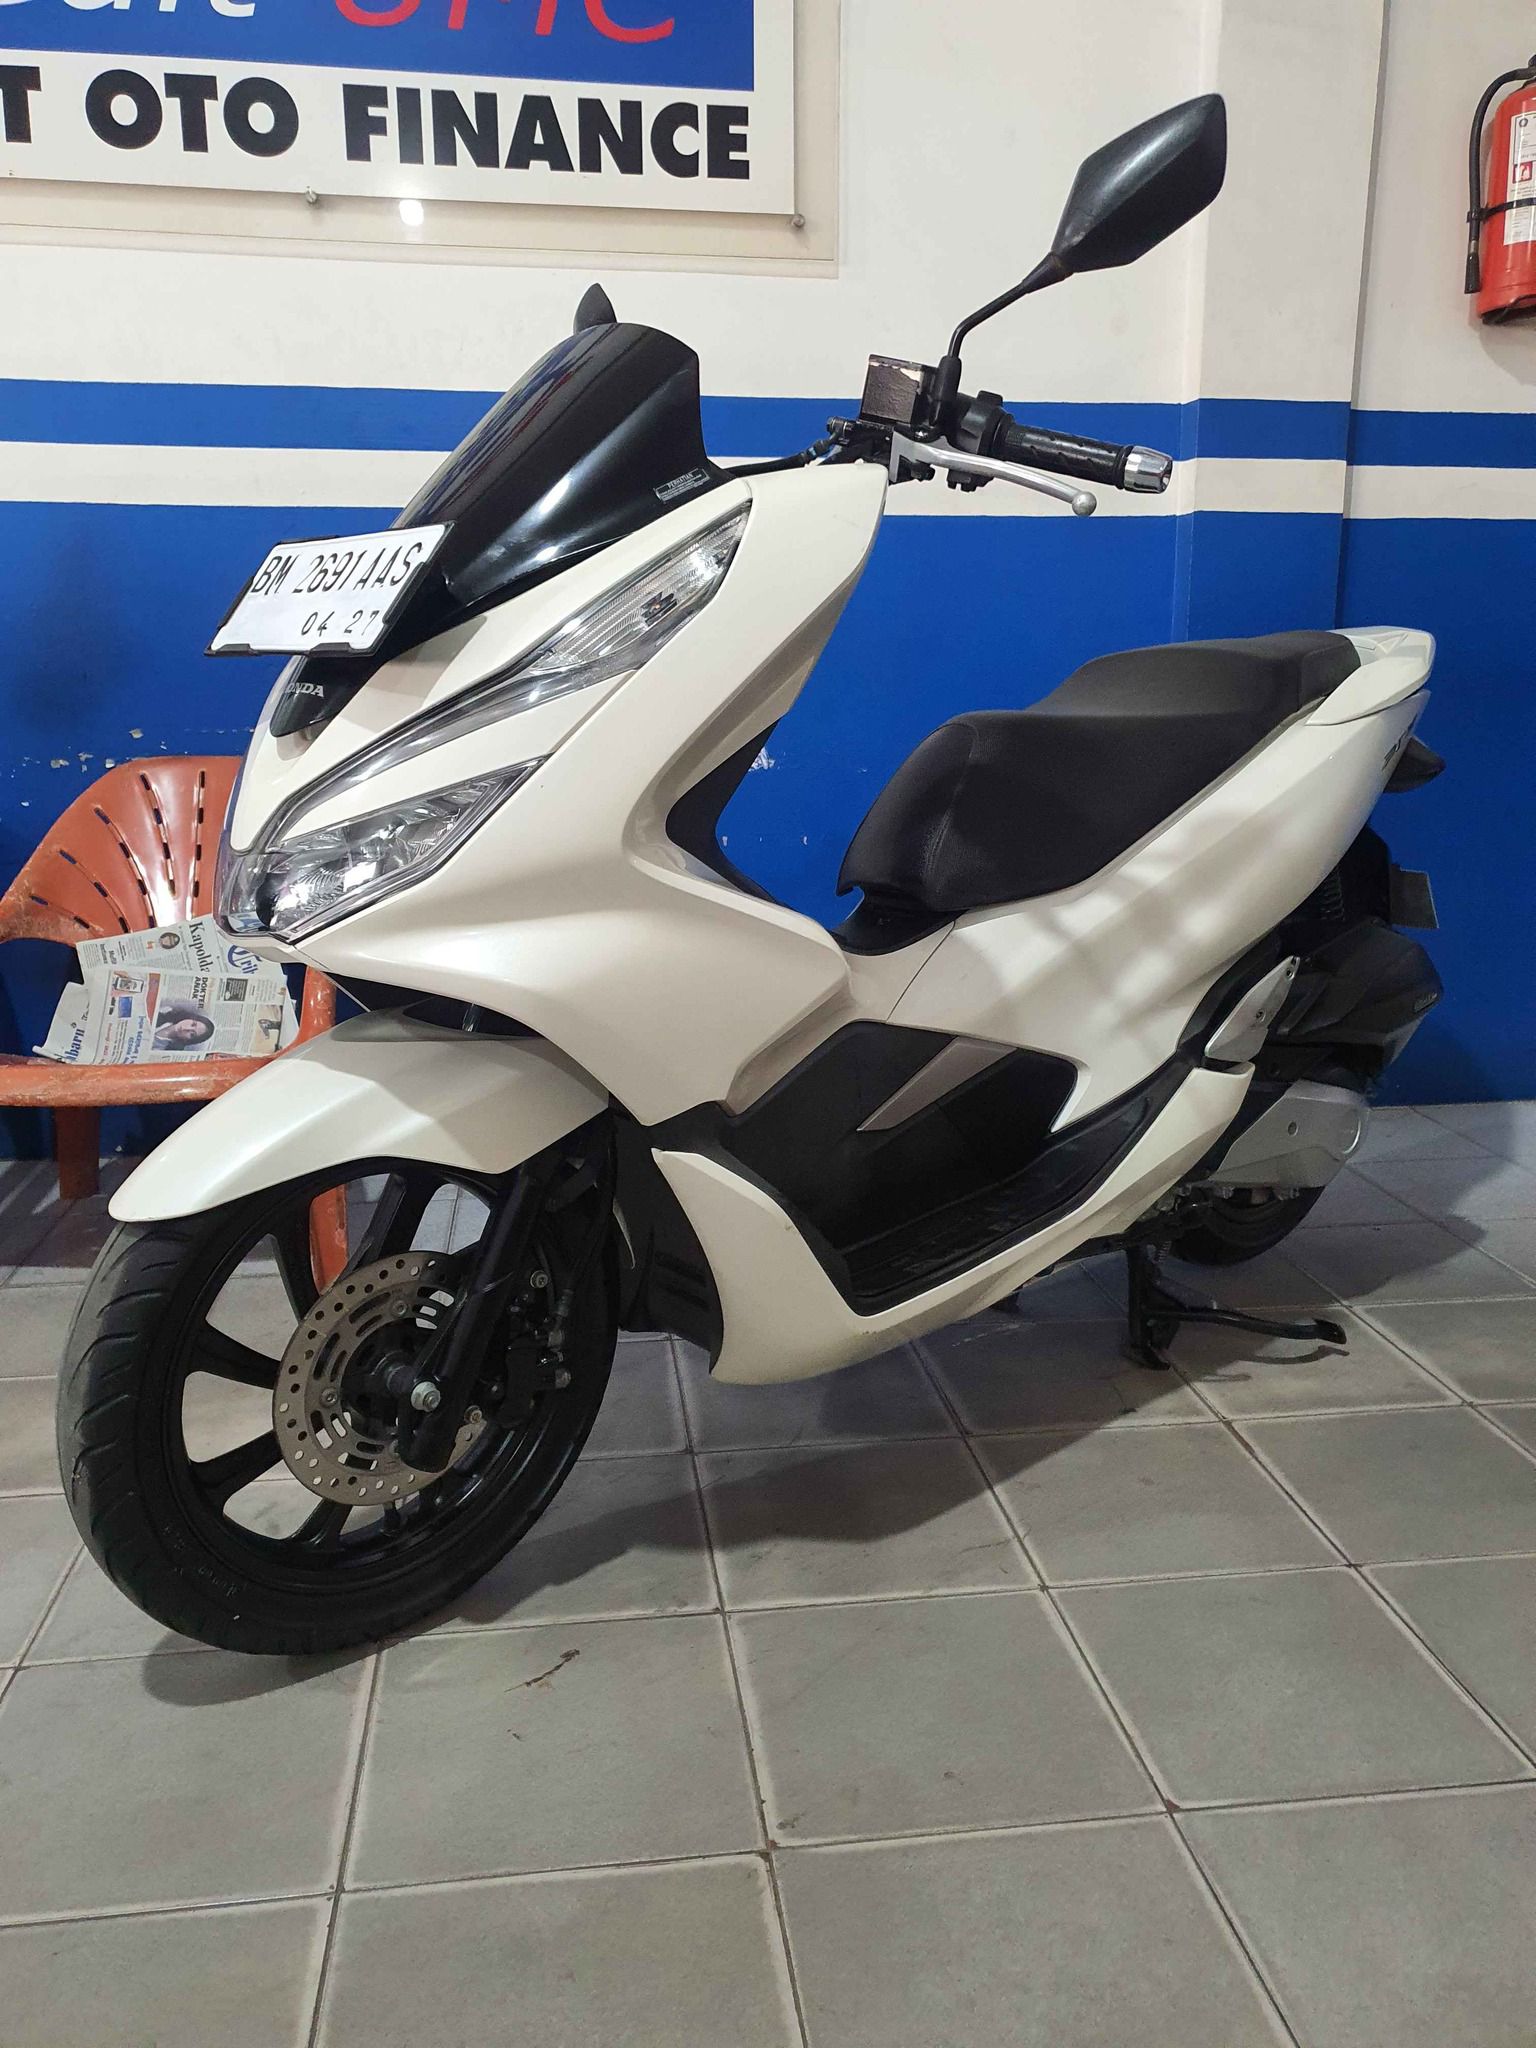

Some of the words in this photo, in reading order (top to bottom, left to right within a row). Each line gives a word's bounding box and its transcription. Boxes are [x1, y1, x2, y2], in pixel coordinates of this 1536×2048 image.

[85, 69, 299, 157] OTO
[343, 83, 750, 180] FINANCE
[251, 554, 301, 595] BM
[292, 551, 368, 593] 2691
[353, 542, 424, 590] AAS
[301, 611, 335, 637] 04
[344, 610, 380, 635] 27
[285, 682, 324, 698] ONDA
